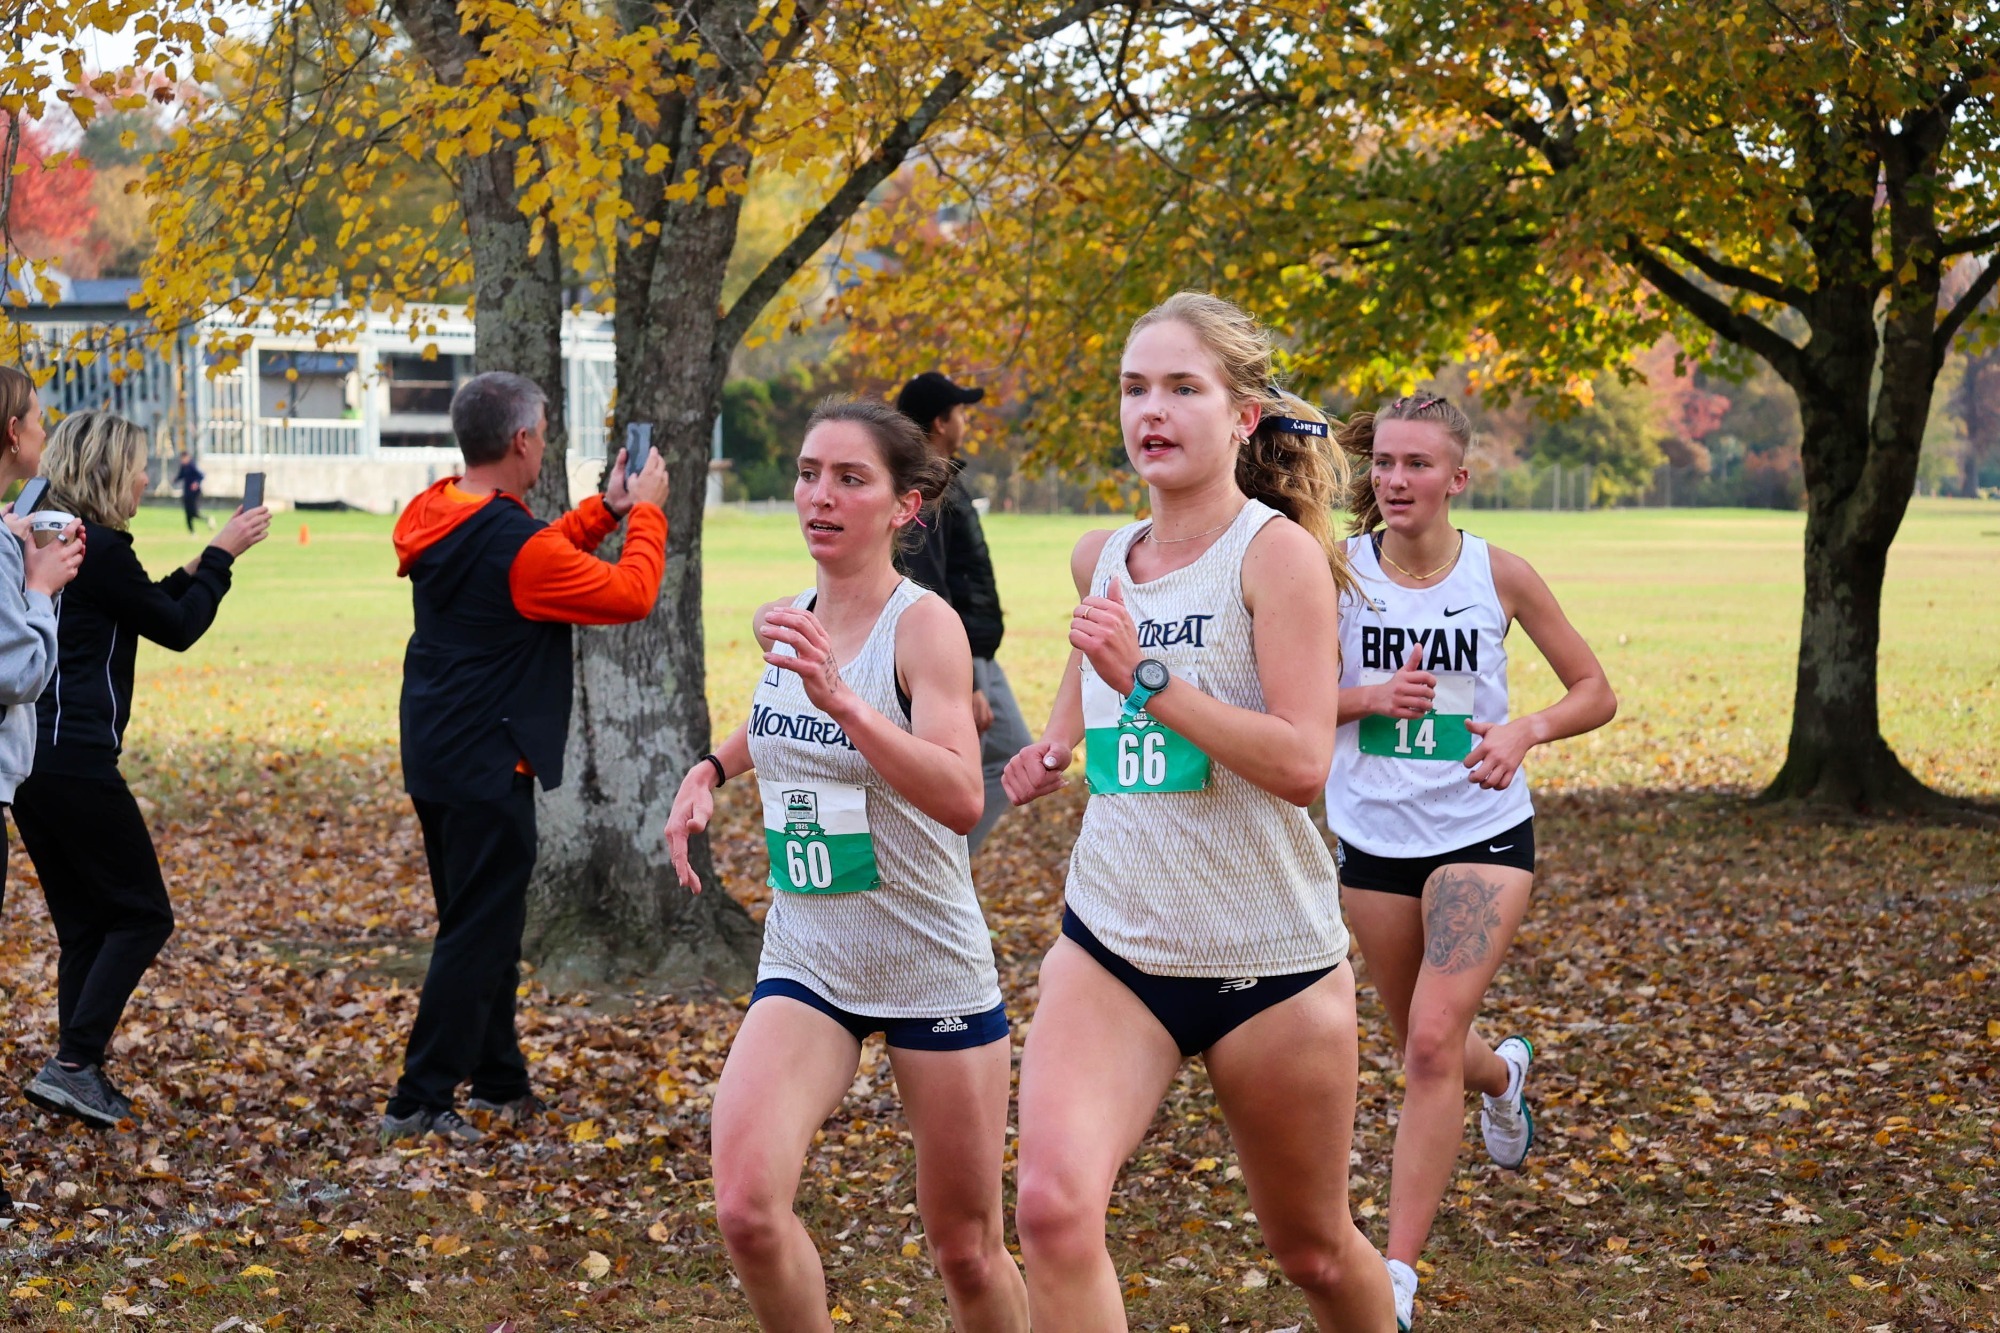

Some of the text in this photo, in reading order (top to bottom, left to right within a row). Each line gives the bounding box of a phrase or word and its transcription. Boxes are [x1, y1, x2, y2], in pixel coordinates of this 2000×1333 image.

[1291, 419, 1323, 435] Macy
[1362, 626, 1479, 671] BRYAN
[1393, 718, 1437, 755] 14
[1117, 731, 1166, 787] 66
[790, 793, 809, 805] AAC
[785, 839, 833, 889] 60
[932, 1022, 969, 1033] adidas
